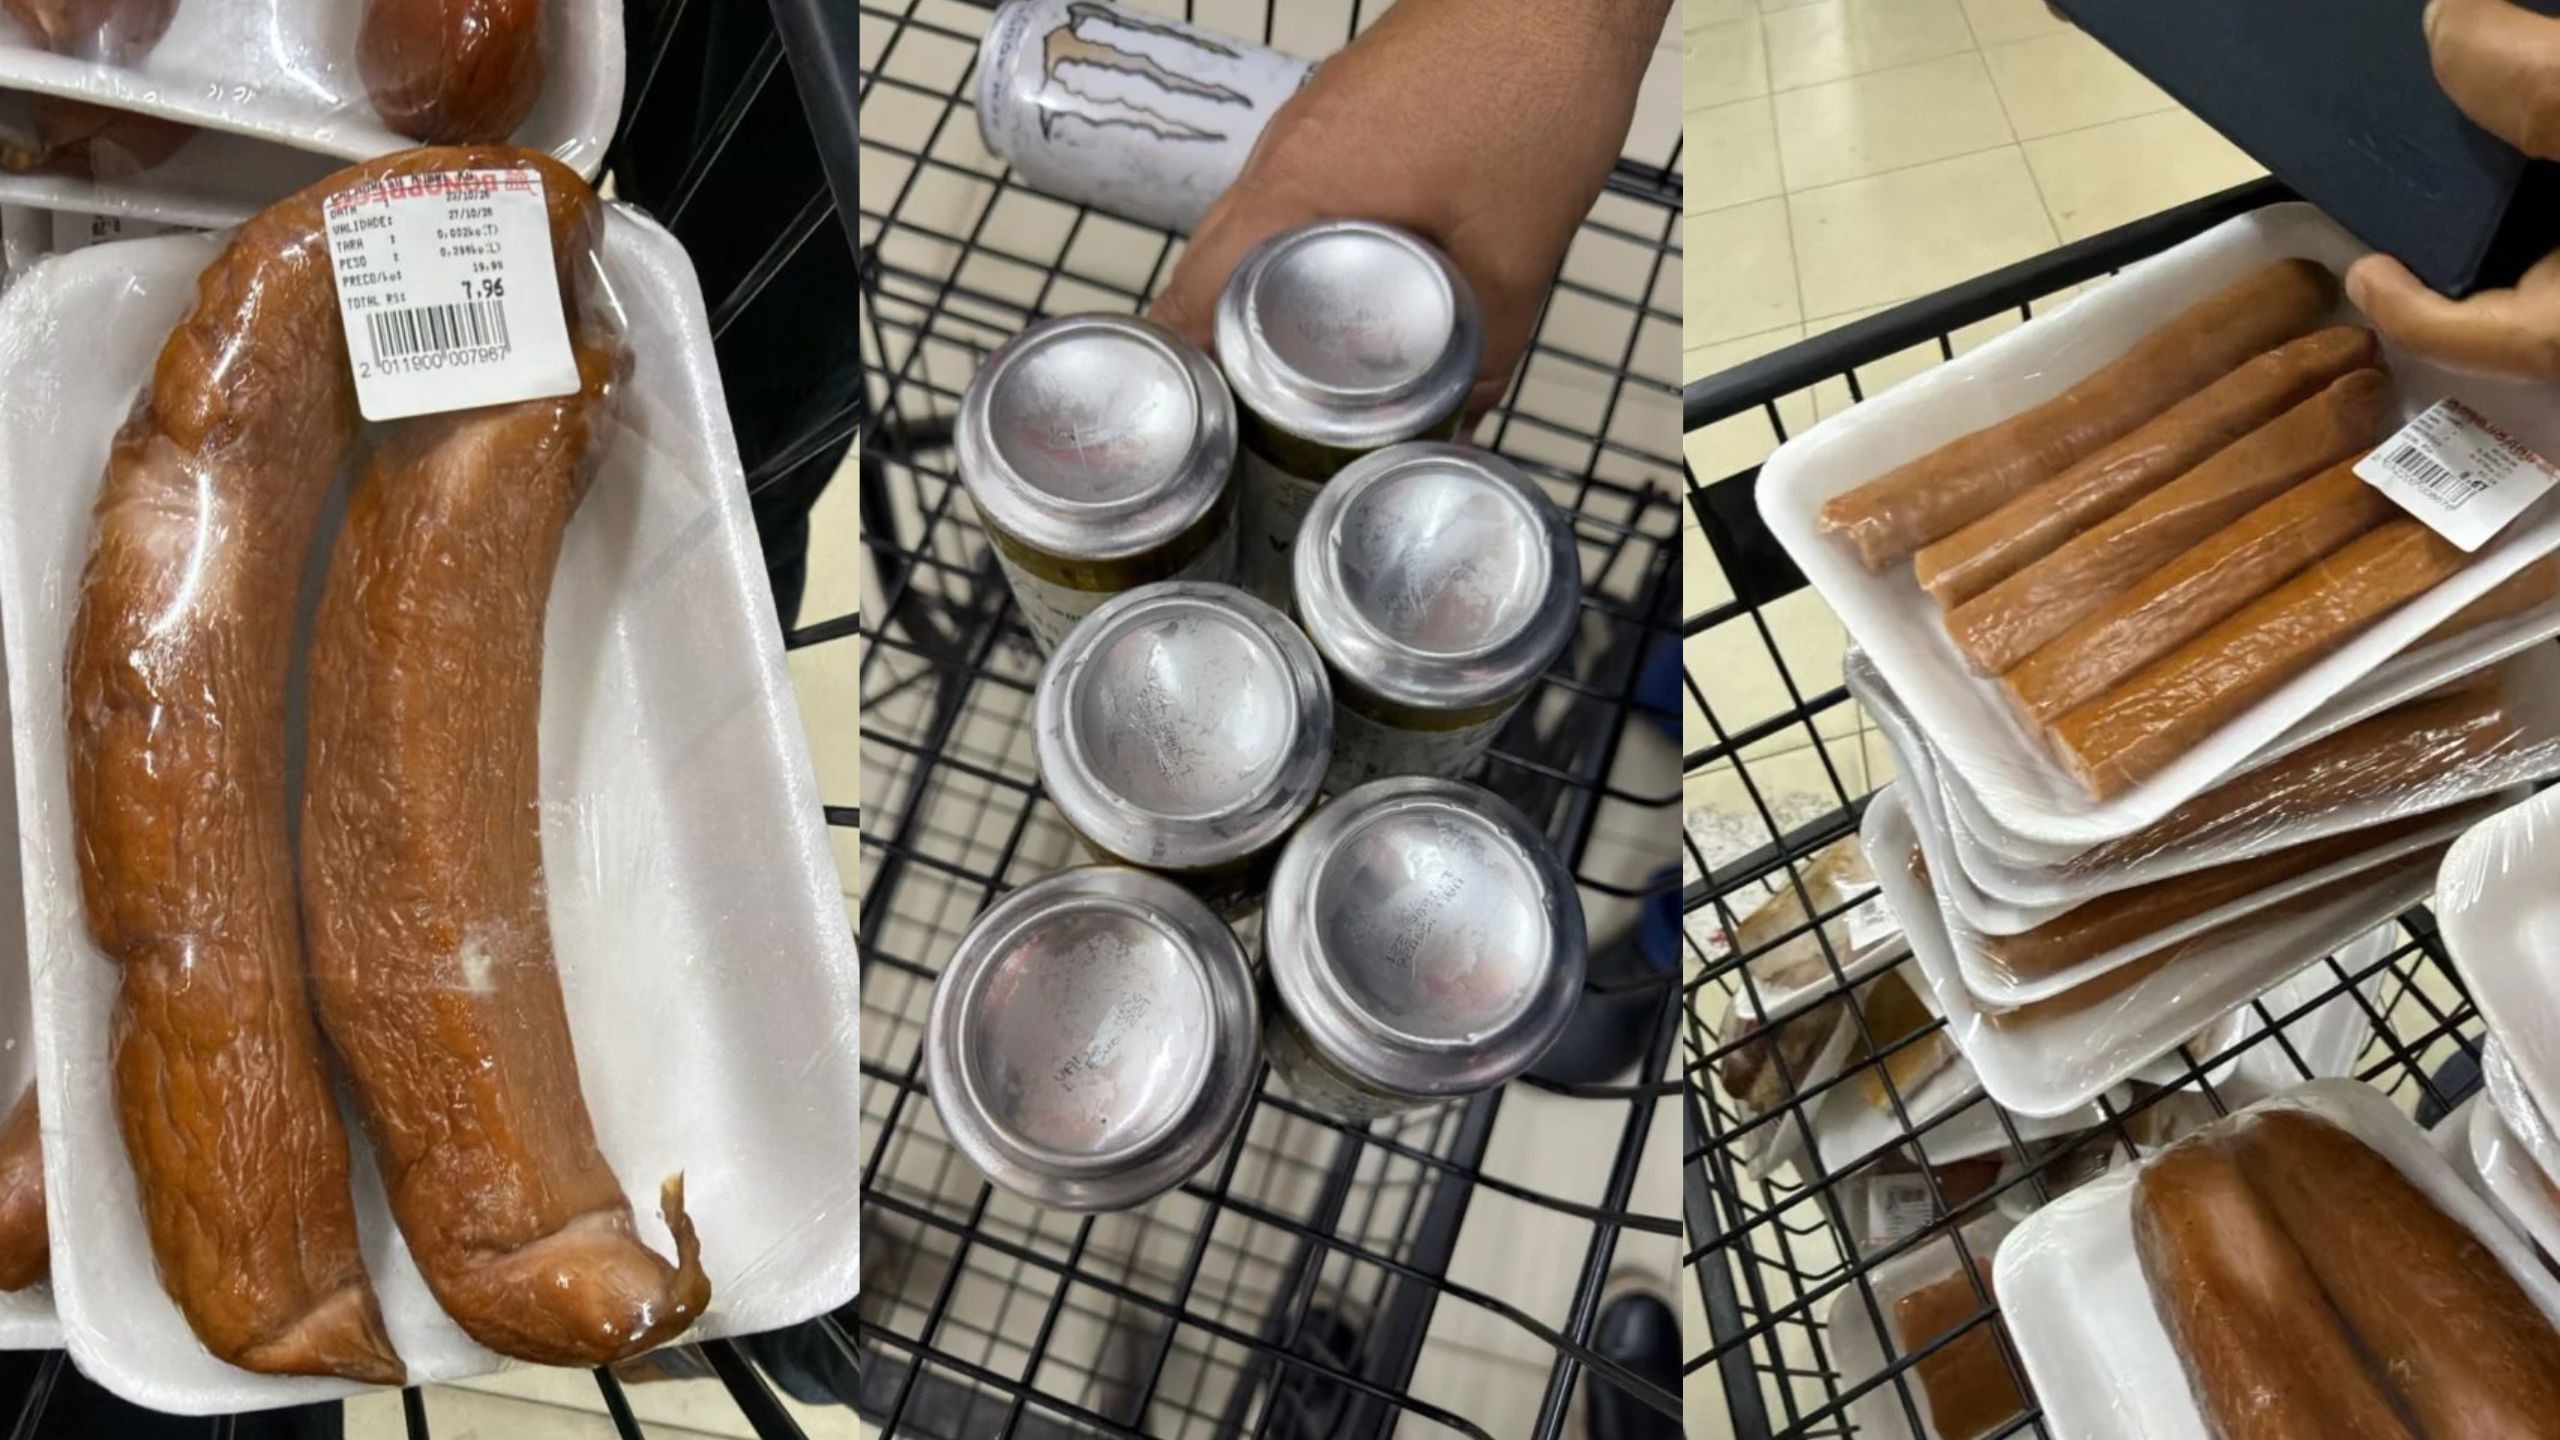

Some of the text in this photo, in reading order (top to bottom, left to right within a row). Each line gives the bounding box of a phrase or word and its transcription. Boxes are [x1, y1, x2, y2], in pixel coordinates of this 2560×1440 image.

[333, 215, 393, 235] VALIDADE:
[337, 238, 364, 253] TARA
[340, 255, 367, 270] PESO
[347, 295, 380, 310] TOTAL
